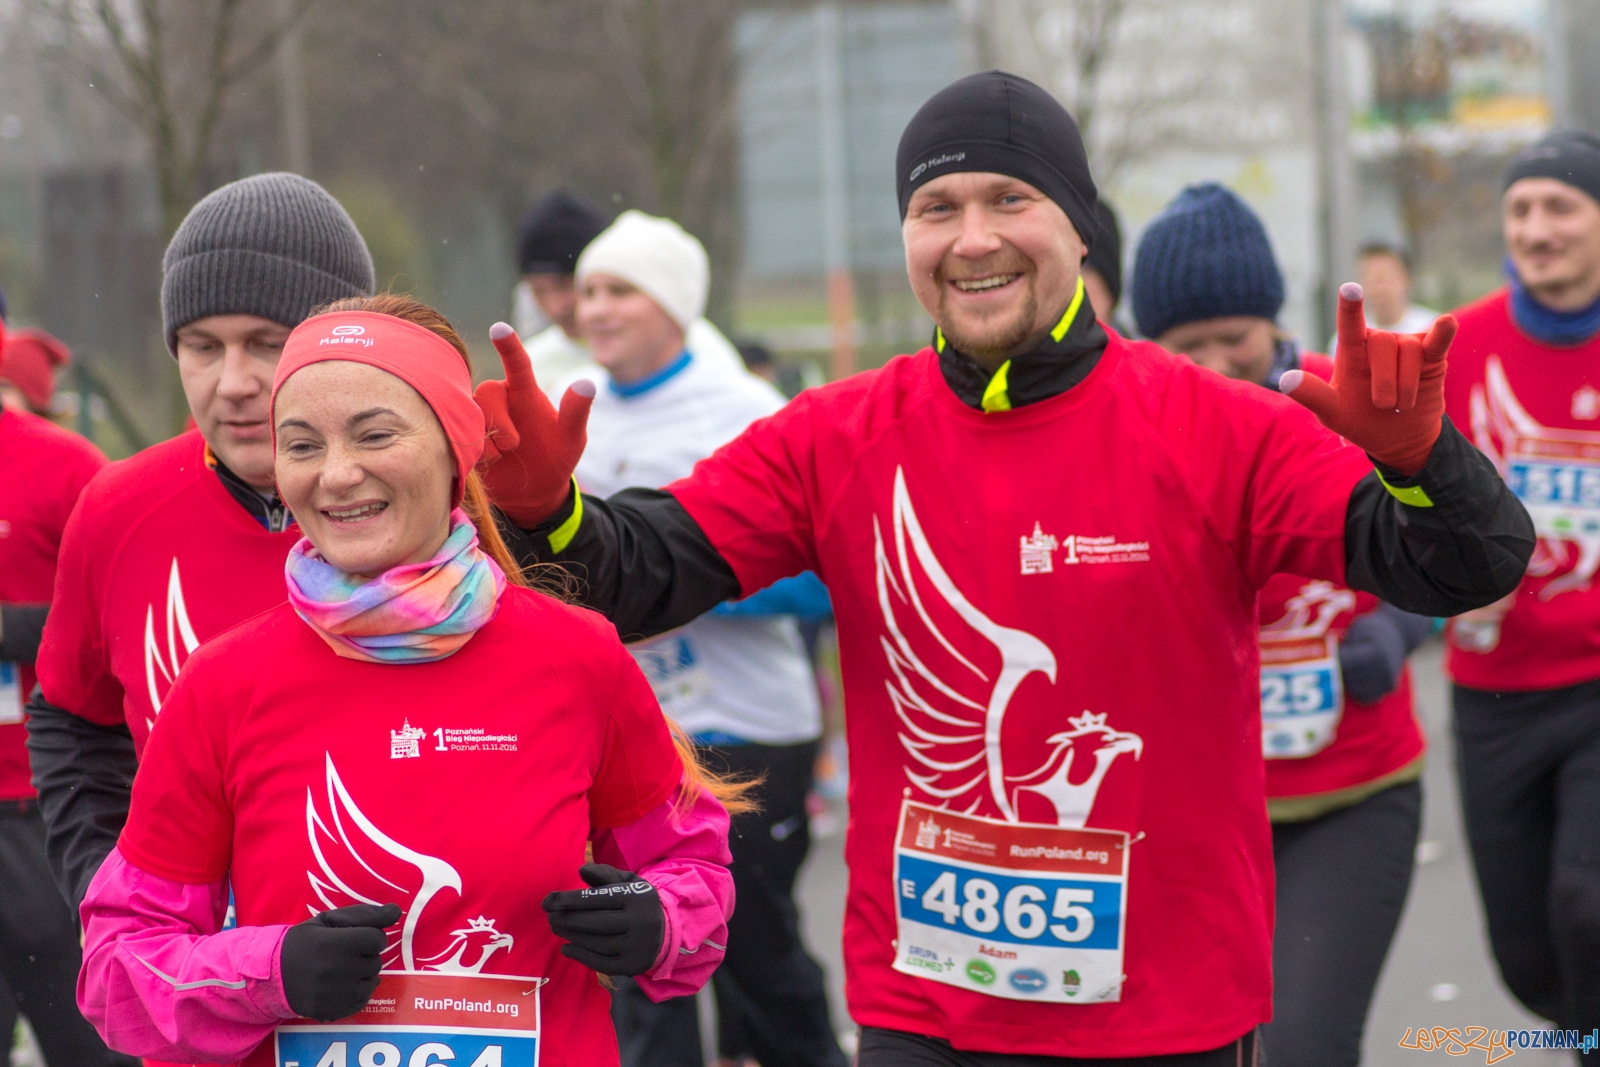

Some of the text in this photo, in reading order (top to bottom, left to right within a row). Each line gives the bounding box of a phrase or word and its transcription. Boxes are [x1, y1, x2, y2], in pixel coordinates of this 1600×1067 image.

[319, 336, 374, 347] Kalenji
[1062, 534, 1079, 564] 1
[1261, 674, 1324, 713] 25
[433, 727, 448, 751] 1
[445, 734, 518, 743] Bieg Niepodległości
[481, 743, 518, 751] 11.11.2016
[1009, 844, 1109, 865] RunPoland.org
[582, 886, 631, 898] Kalenji
[901, 871, 1095, 943] E 4865
[978, 944, 1018, 960] Adam
[414, 997, 519, 1017] RunPoland.org
